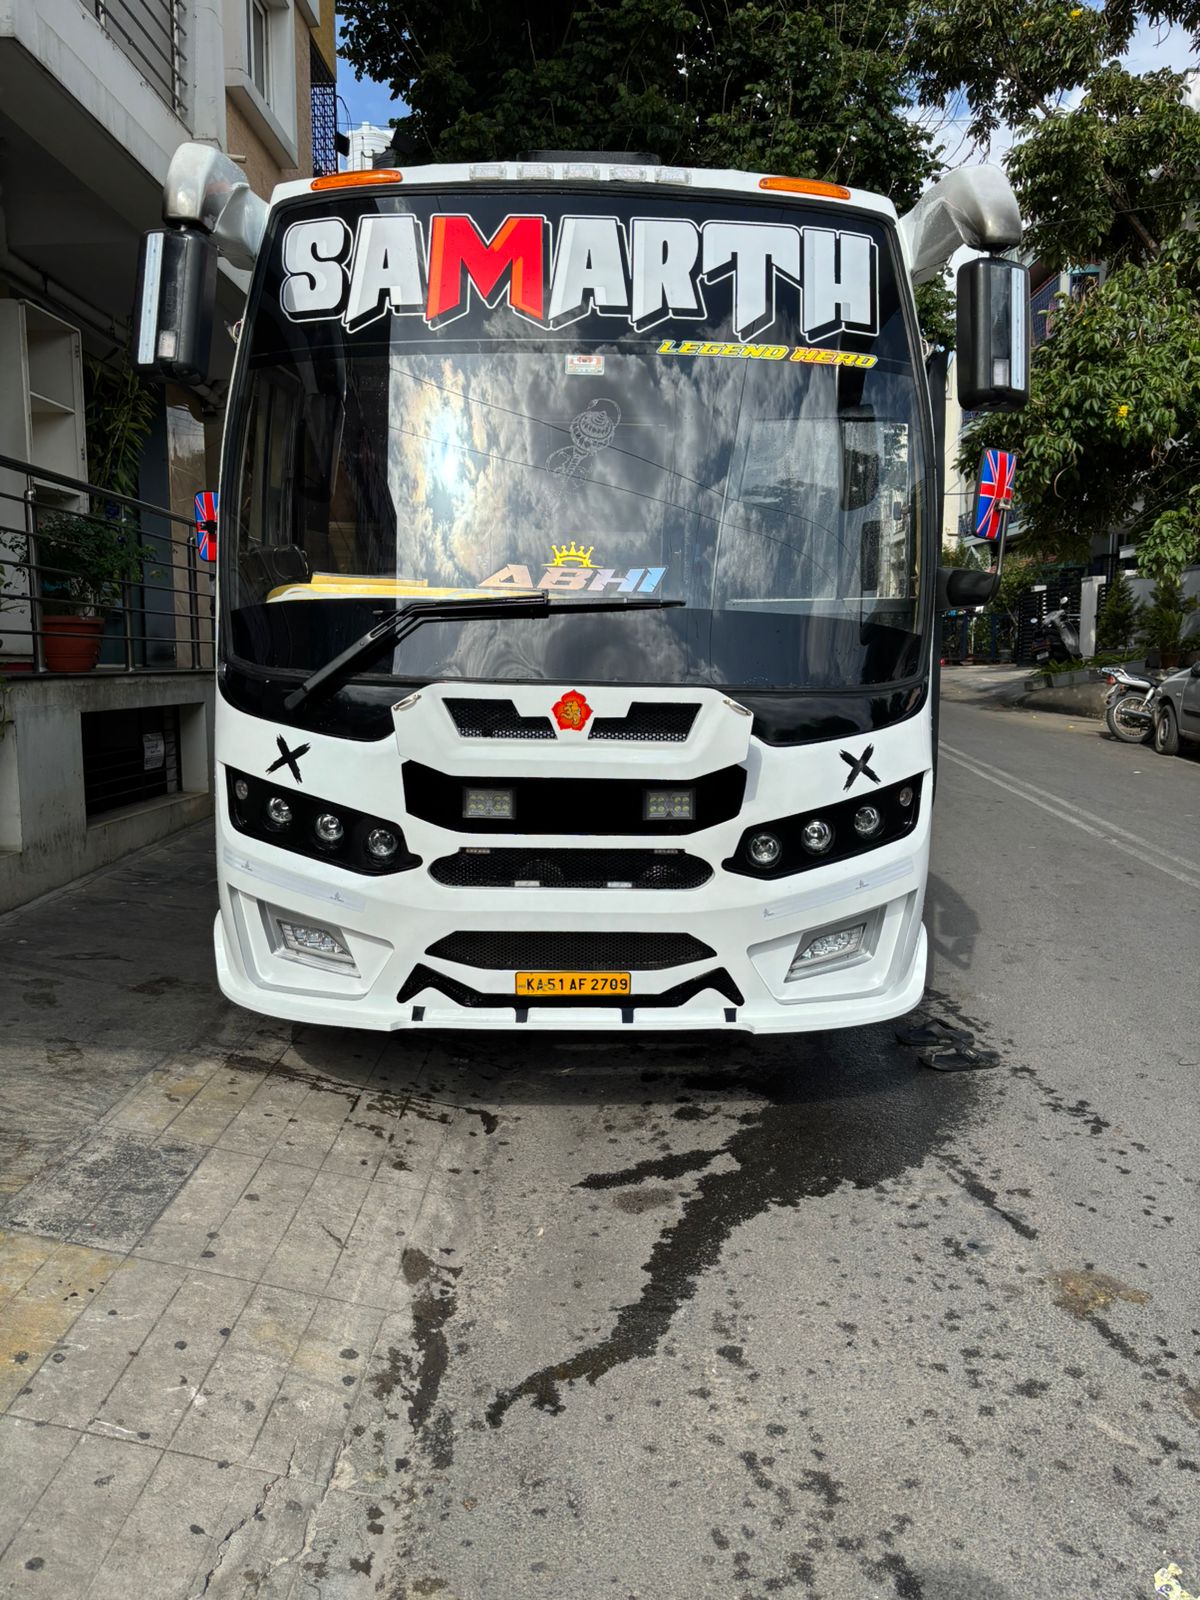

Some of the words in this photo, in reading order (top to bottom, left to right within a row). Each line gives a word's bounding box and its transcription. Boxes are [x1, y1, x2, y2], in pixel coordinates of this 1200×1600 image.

[280, 213, 880, 343] SAMARTH
[656, 339, 790, 360] LEGEND
[790, 346, 879, 368] HERO
[478, 563, 669, 593] ABHI
